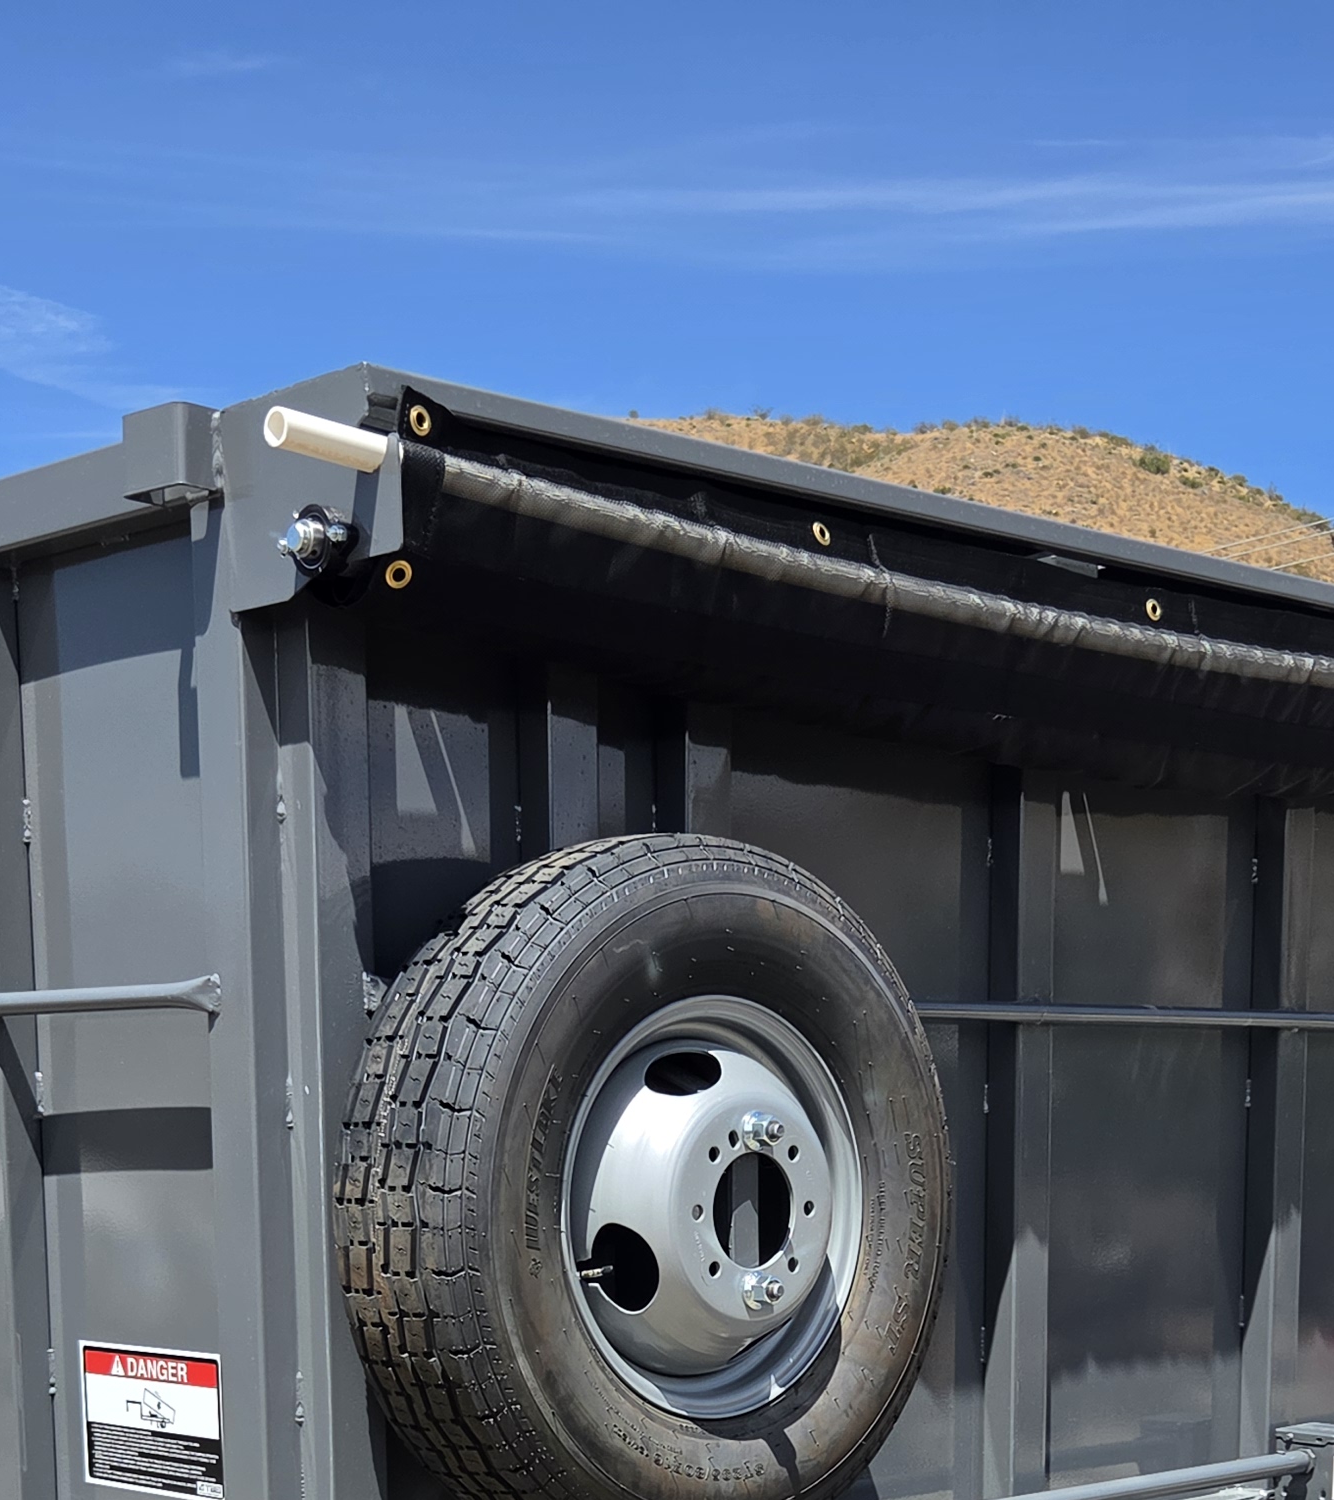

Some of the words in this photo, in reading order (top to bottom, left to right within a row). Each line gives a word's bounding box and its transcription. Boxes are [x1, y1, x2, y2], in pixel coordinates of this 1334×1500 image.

[524, 1067, 563, 1251] WESTLAKE
[903, 1131, 926, 1280] SUPER
[126, 1357, 188, 1383] DANGER
